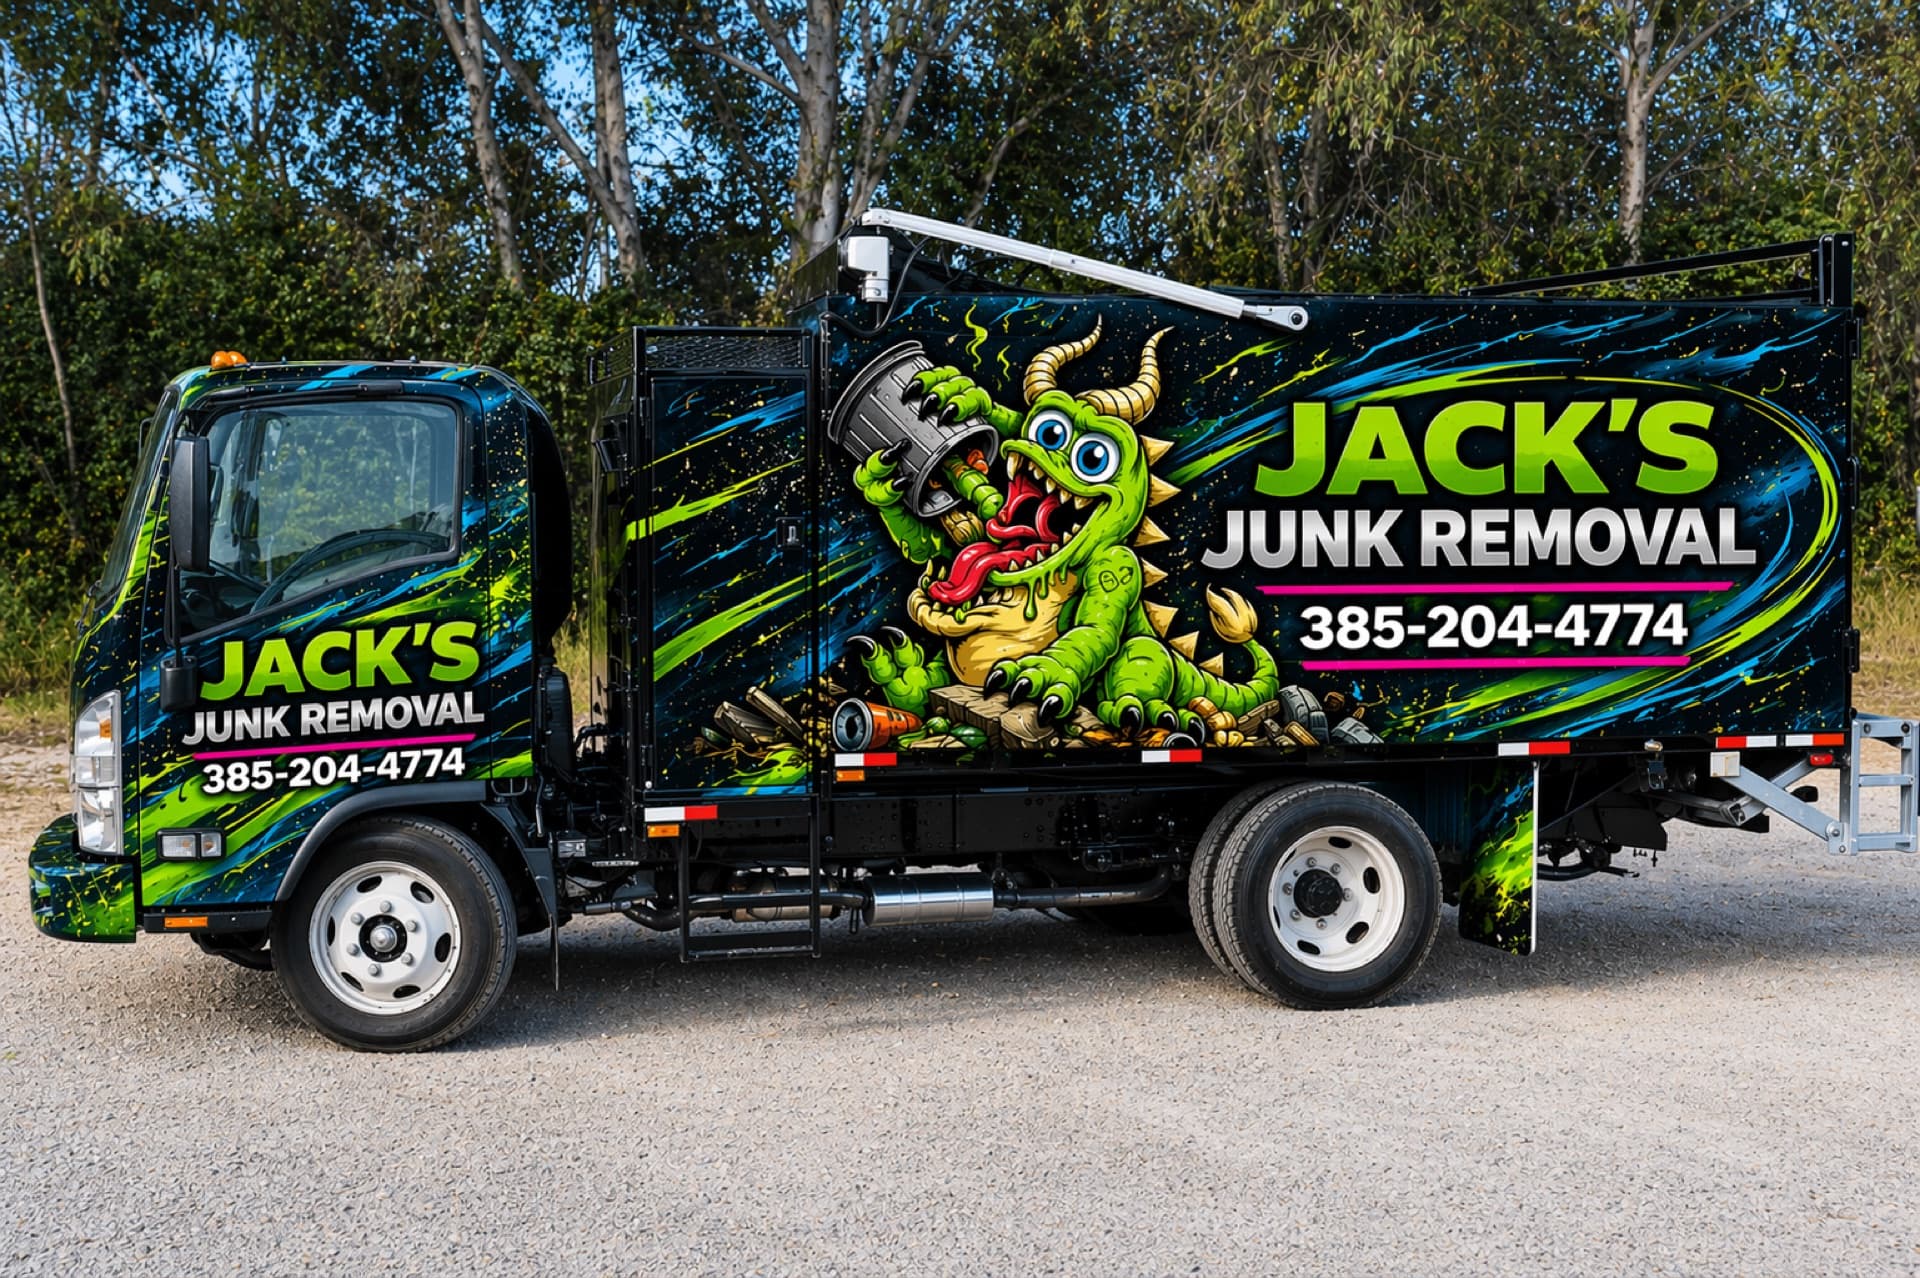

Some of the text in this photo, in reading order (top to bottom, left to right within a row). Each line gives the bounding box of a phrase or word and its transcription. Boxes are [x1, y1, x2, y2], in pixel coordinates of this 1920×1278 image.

[1256, 399, 1718, 495] JACK'S
[1202, 508, 1756, 568] JUNK REMOVAL
[1300, 604, 1688, 649] 385-204-4774
[202, 622, 479, 700] JACK'S
[183, 691, 485, 745] JUNK REMOVAL
[203, 748, 465, 794] 385-204-4774
